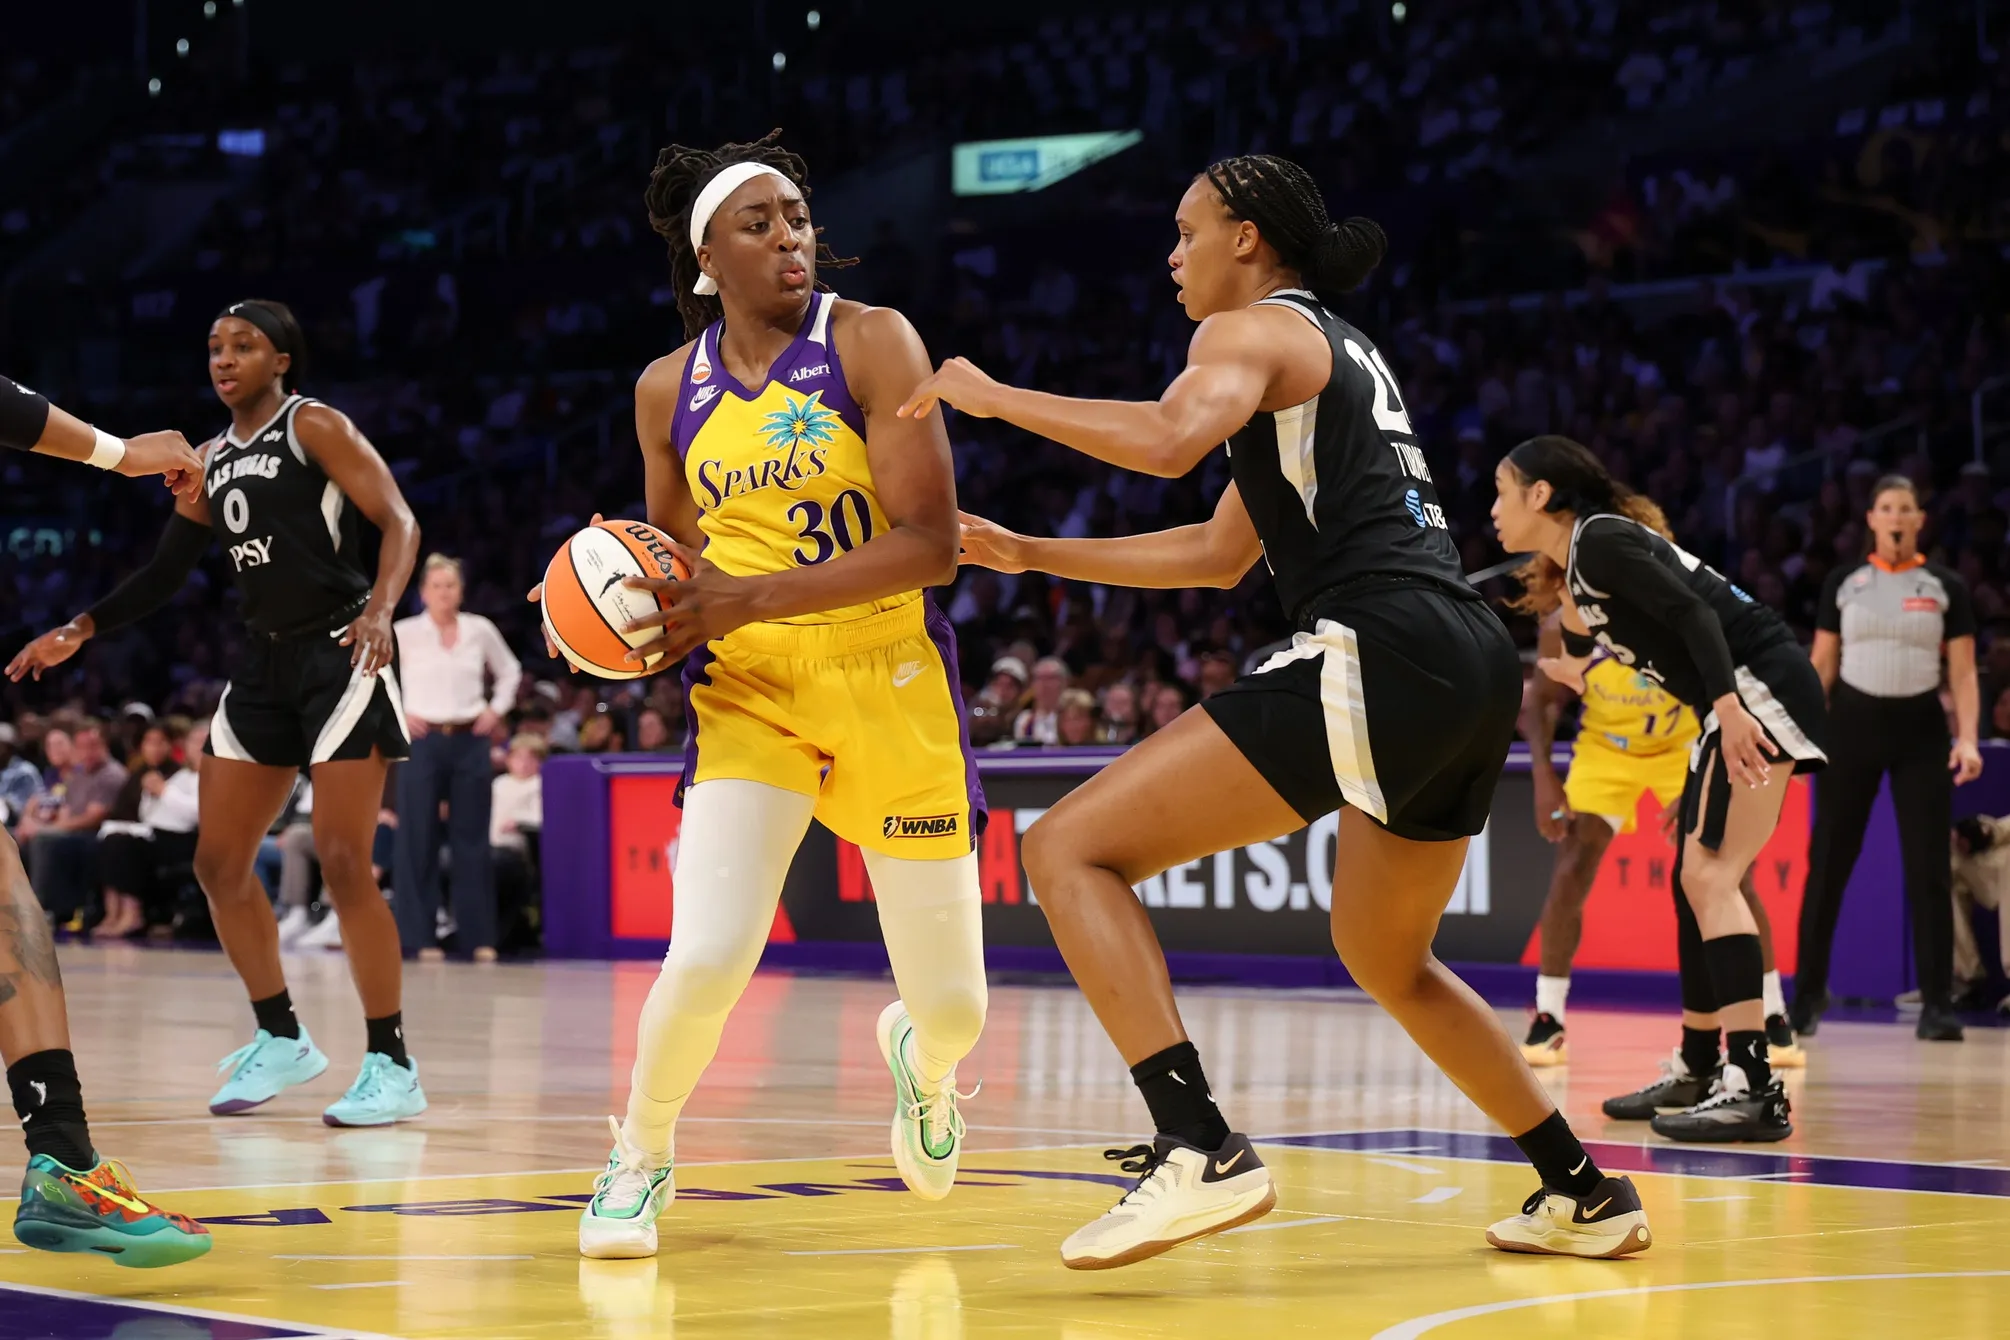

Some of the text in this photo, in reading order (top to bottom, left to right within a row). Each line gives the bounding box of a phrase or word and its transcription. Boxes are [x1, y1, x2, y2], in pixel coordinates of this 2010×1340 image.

[789, 363, 832, 382] Albert
[694, 385, 717, 401] NIKE
[207, 453, 282, 499] LAS VEGAS
[223, 488, 250, 534] 0
[786, 489, 873, 566] 30
[897, 660, 920, 677] NIKE
[901, 817, 957, 835] WNBA
